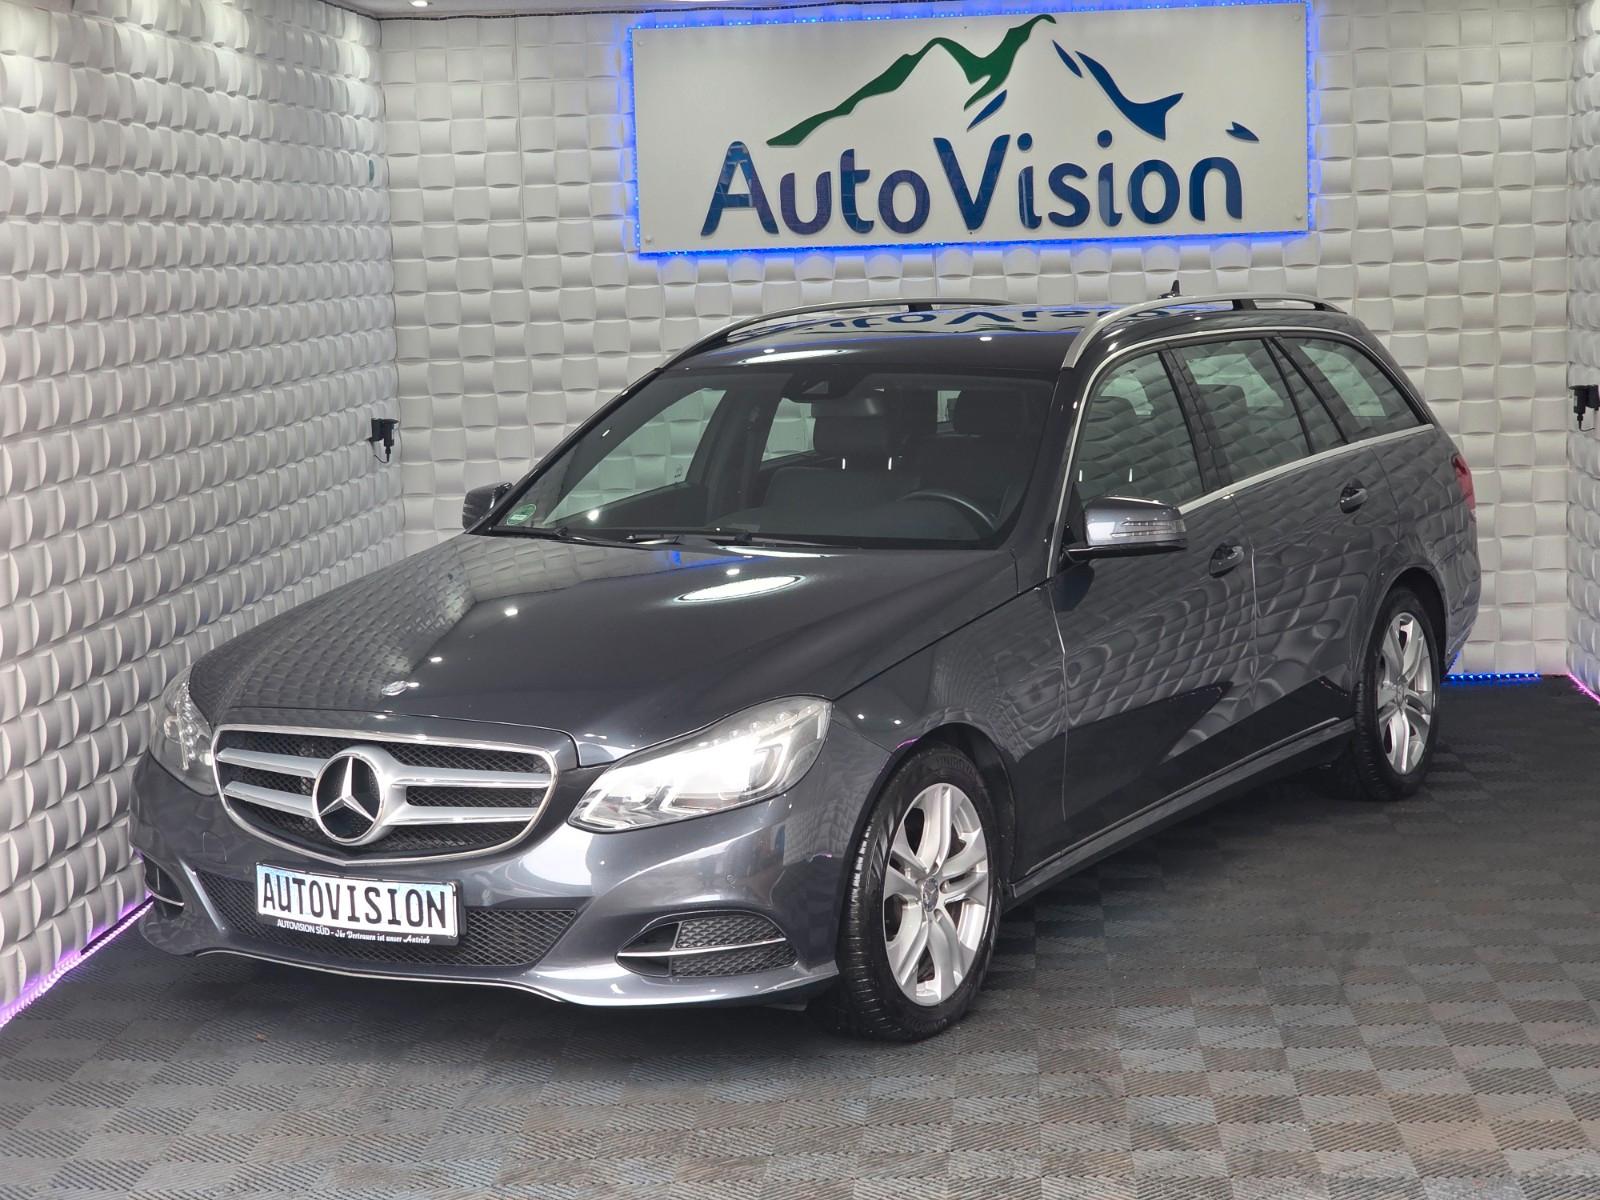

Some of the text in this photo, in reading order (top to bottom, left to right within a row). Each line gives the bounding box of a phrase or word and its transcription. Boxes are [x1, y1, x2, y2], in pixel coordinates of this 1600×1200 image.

[701, 130, 1243, 236] AutoVision
[263, 872, 447, 929] AUTOVISION
[277, 919, 315, 934] AUTOVISION
[315, 925, 330, 936] SÜD
[346, 930, 376, 941] Vertrauen
[403, 934, 431, 944] Antrieb
